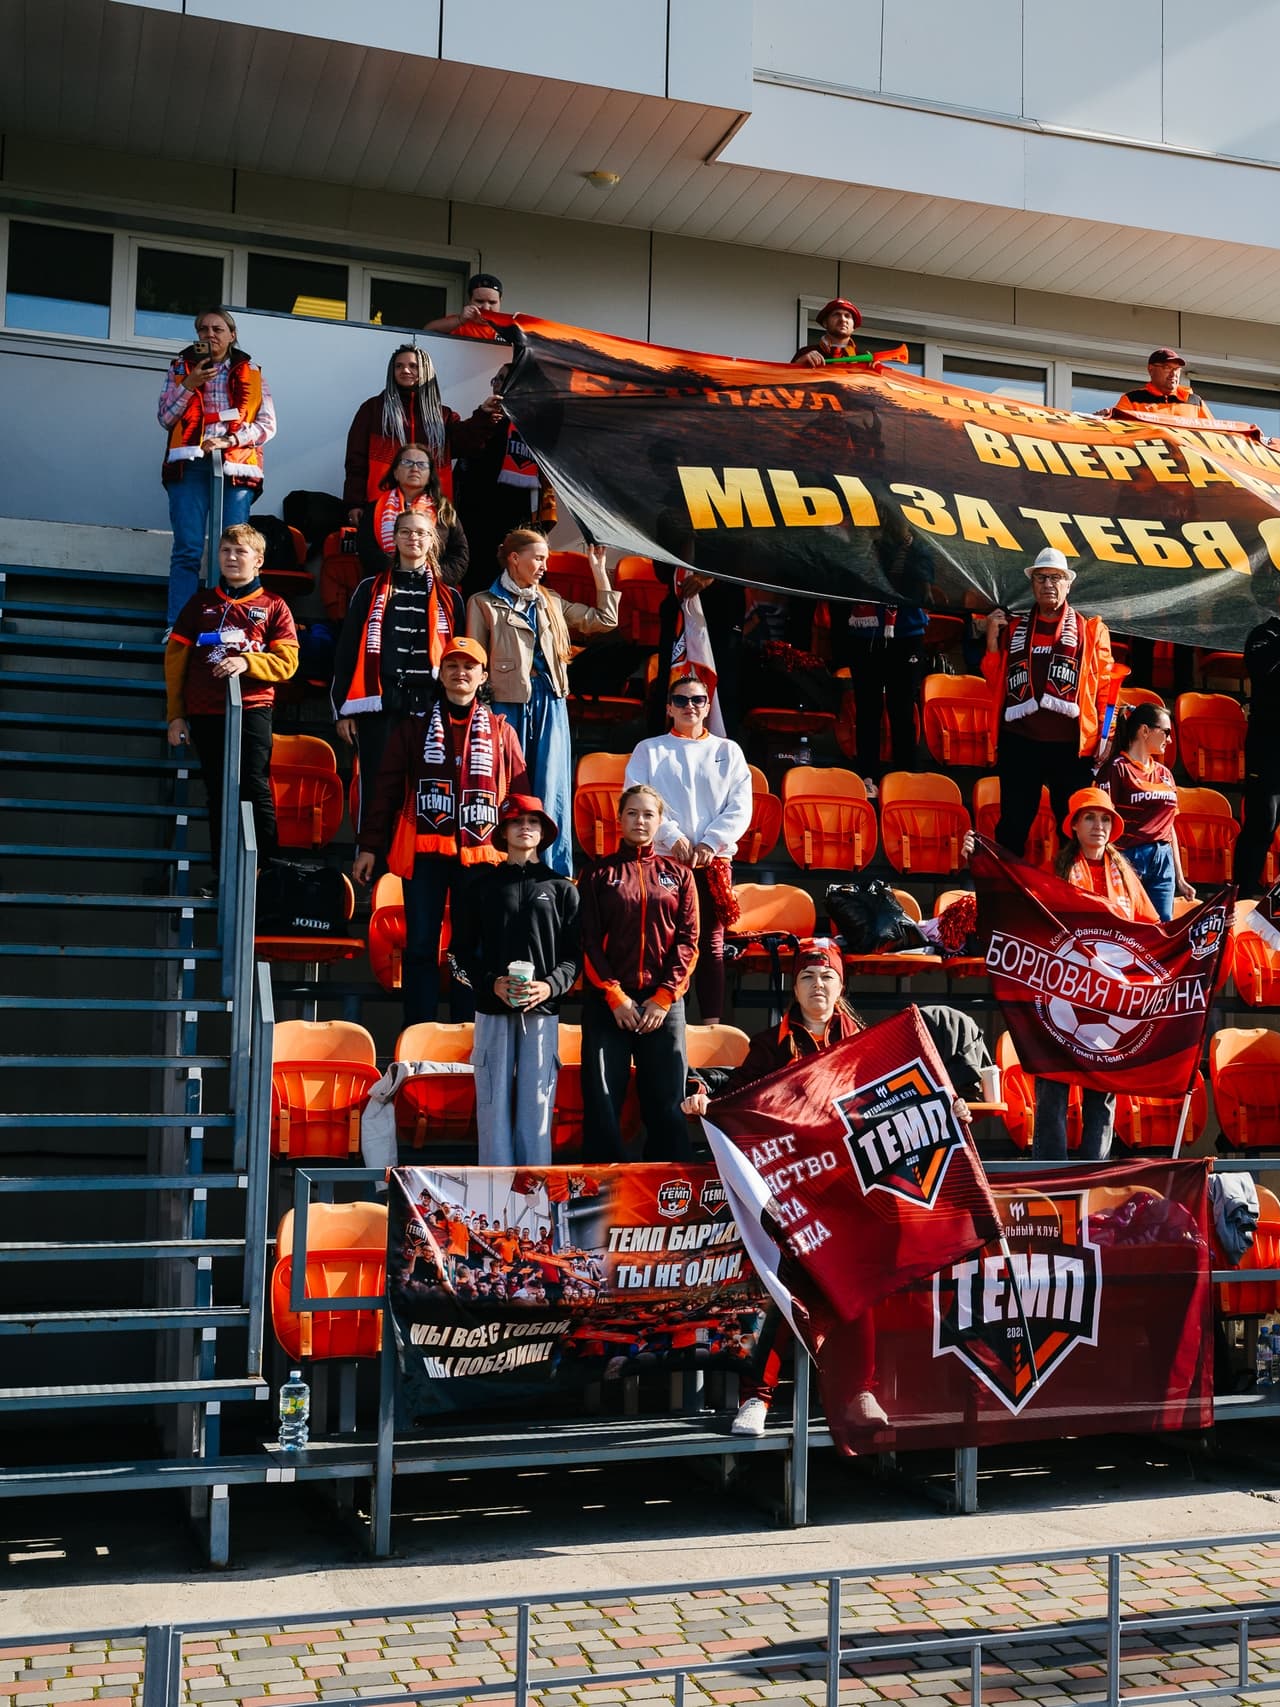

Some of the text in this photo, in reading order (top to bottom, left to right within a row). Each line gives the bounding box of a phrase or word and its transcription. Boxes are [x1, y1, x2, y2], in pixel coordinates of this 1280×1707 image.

[964, 422, 1243, 488] ВПЕРЁД
[677, 466, 880, 529] МЫ
[890, 483, 1024, 551] ЗА
[1019, 506, 1251, 575] ТЕБЯ
[1009, 671, 1028, 690] ТЕМП
[1052, 665, 1076, 685] ТЕМП
[469, 738, 493, 777] ТЕМП
[420, 794, 452, 813] ТЕМП
[462, 804, 496, 823] ТЕМП
[986, 934, 1112, 1008] БОРДОВАЯ
[1117, 979, 1207, 1017] ТРИБУНА
[748, 1134, 796, 1169] АНТ
[857, 1100, 951, 1176] ТЕМП
[764, 1151, 837, 1196] НСТВО
[661, 1190, 690, 1199] ТЕМП
[608, 1226, 667, 1252] ТЕМП
[1004, 1223, 1060, 1238] ЛЬНЫЙ КЛУБ
[617, 1253, 743, 1288] ТЫ НЕ ОДИН,
[952, 1253, 1084, 1330] ТЕМП
[410, 1323, 452, 1347] МЫ
[453, 1342, 553, 1377] ПОБЕДИМ!
